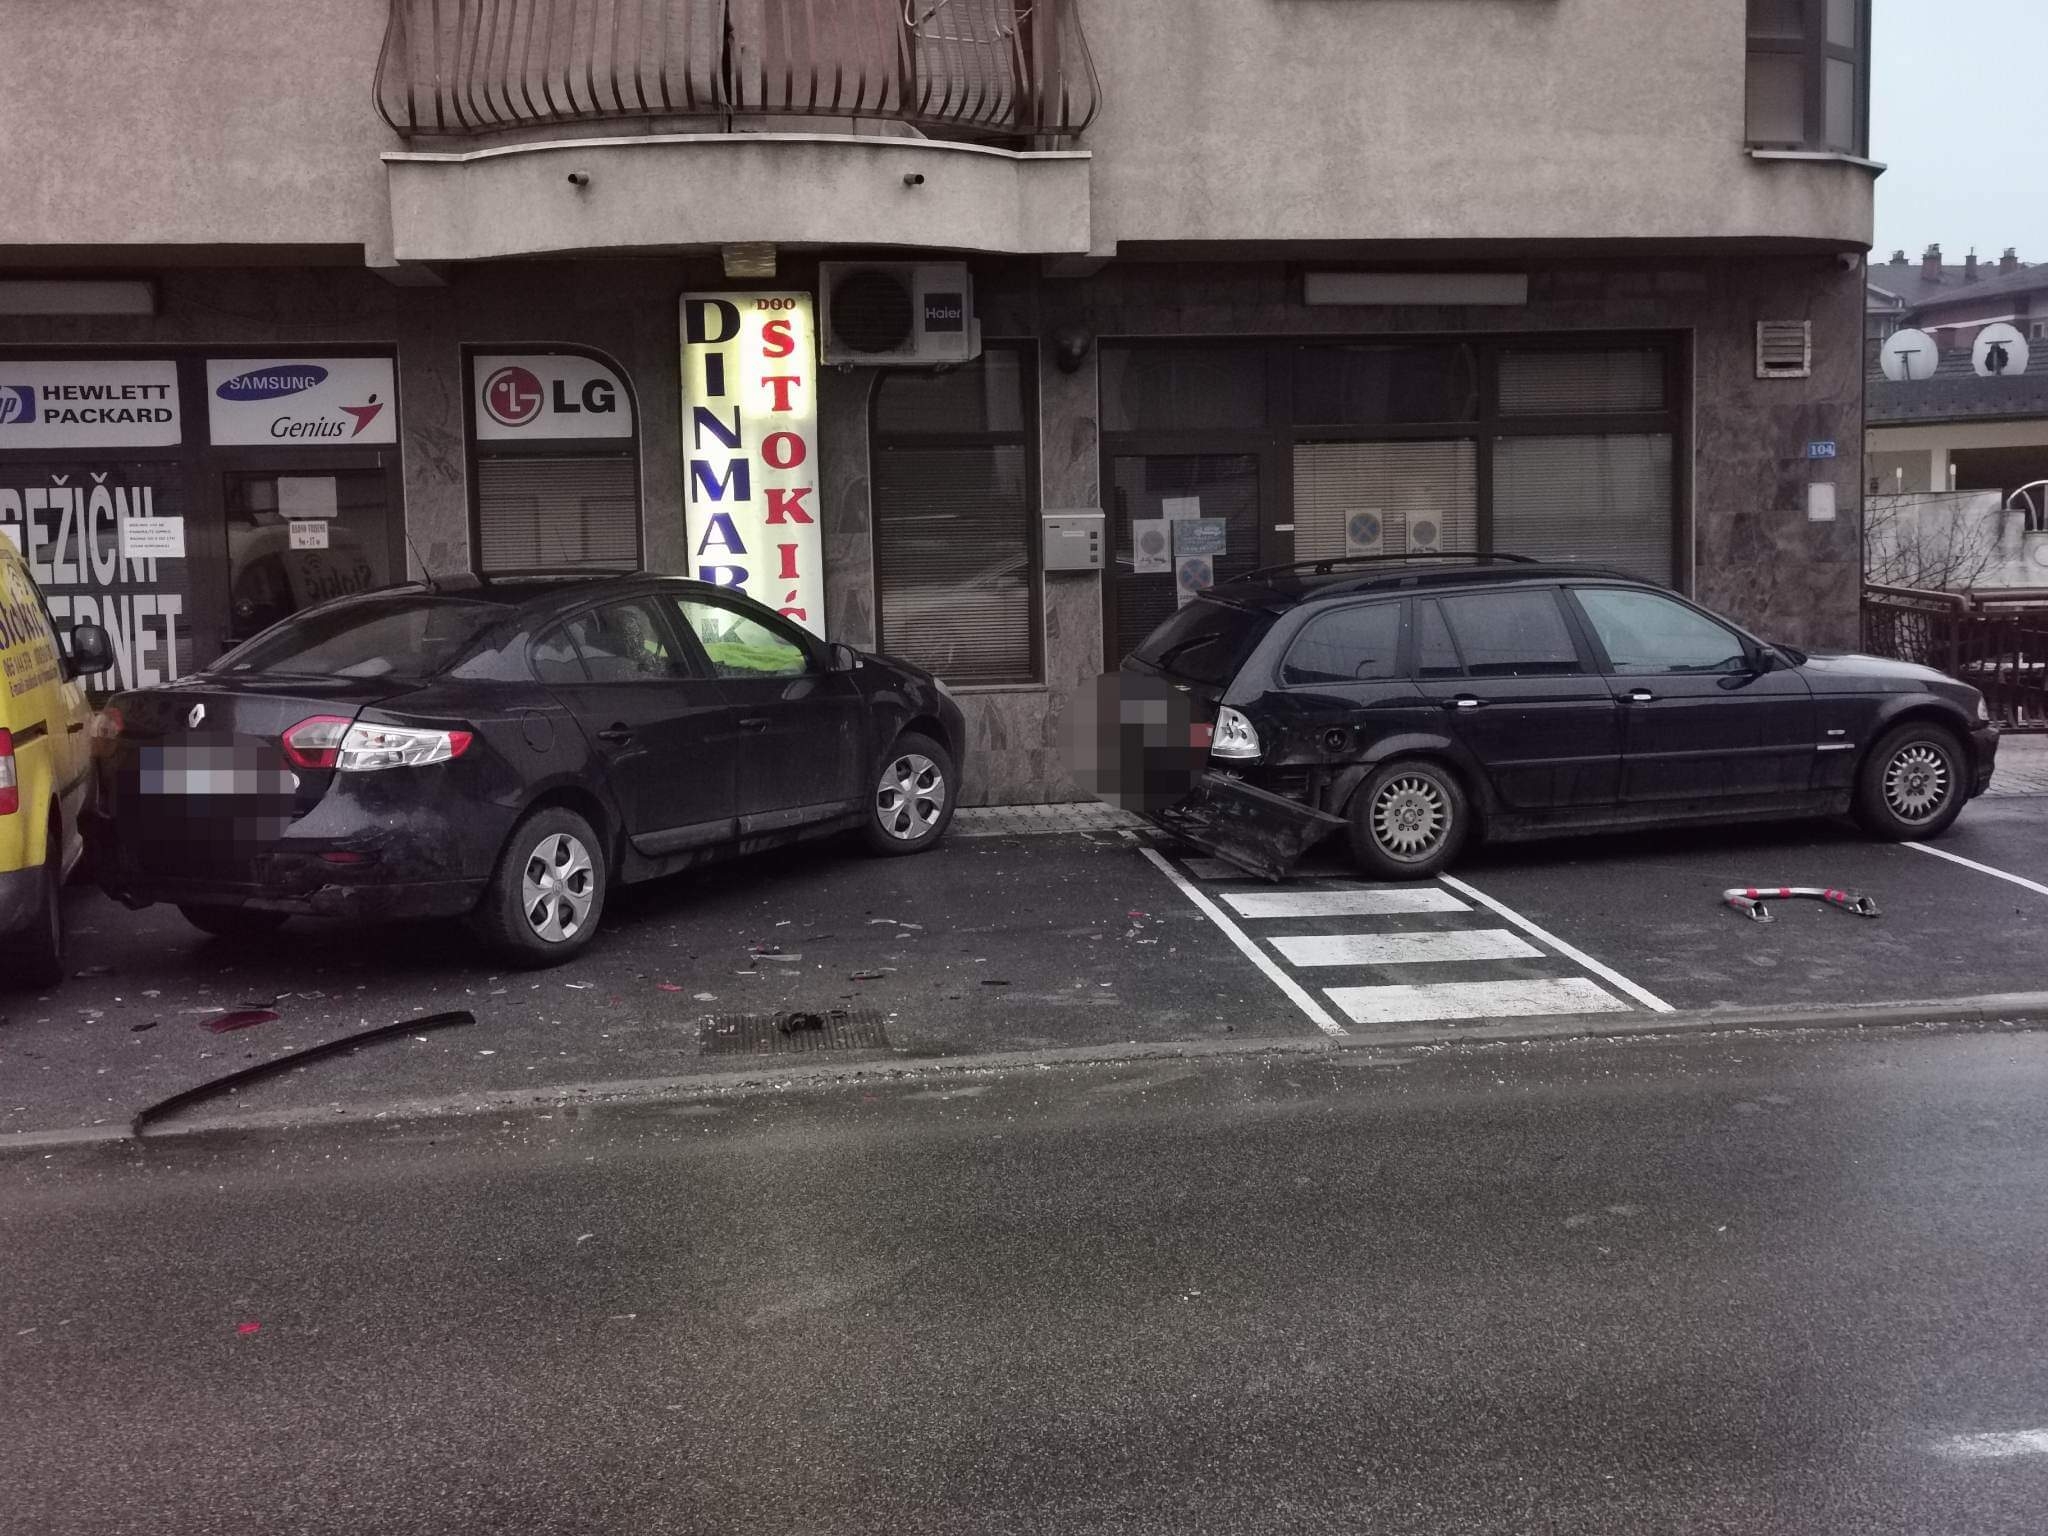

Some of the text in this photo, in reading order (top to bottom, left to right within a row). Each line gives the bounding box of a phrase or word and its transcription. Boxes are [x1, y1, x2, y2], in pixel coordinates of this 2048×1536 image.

[757, 298, 796, 311] DOO
[925, 305, 961, 319] Haier
[229, 375, 317, 391] SAMSUNG
[43, 384, 171, 401] HEWLETT
[552, 379, 617, 414] LG
[44, 407, 173, 424] PACKARD
[269, 415, 347, 438] Genius
[1811, 444, 1833, 456] 104
